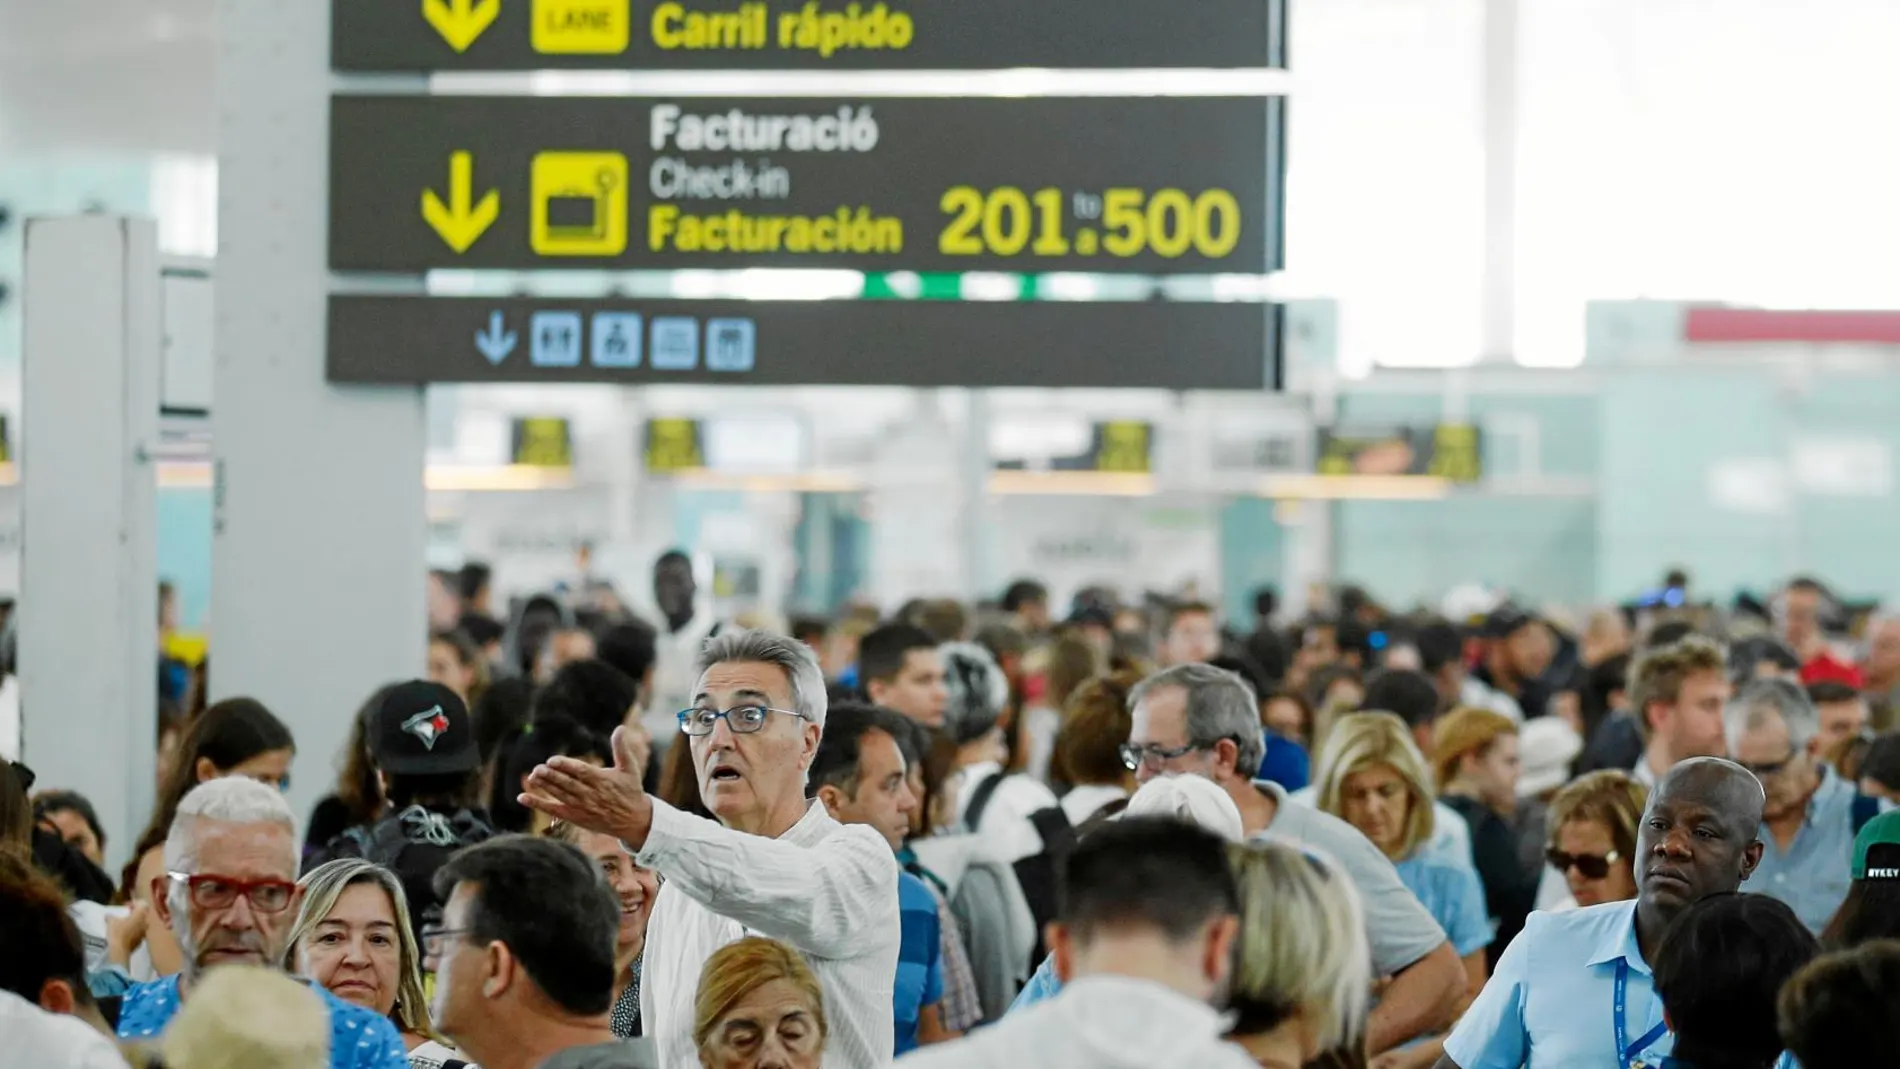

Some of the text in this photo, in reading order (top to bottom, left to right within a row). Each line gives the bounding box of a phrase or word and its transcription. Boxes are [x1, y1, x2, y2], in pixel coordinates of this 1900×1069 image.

[547, 9, 614, 34] LANE
[652, 3, 913, 57] Carril rápido
[650, 104, 878, 151] Facturació
[650, 156, 789, 198] Check-in
[649, 204, 903, 252] Facturación
[939, 186, 1069, 255] 201
[1102, 188, 1240, 257] 500
